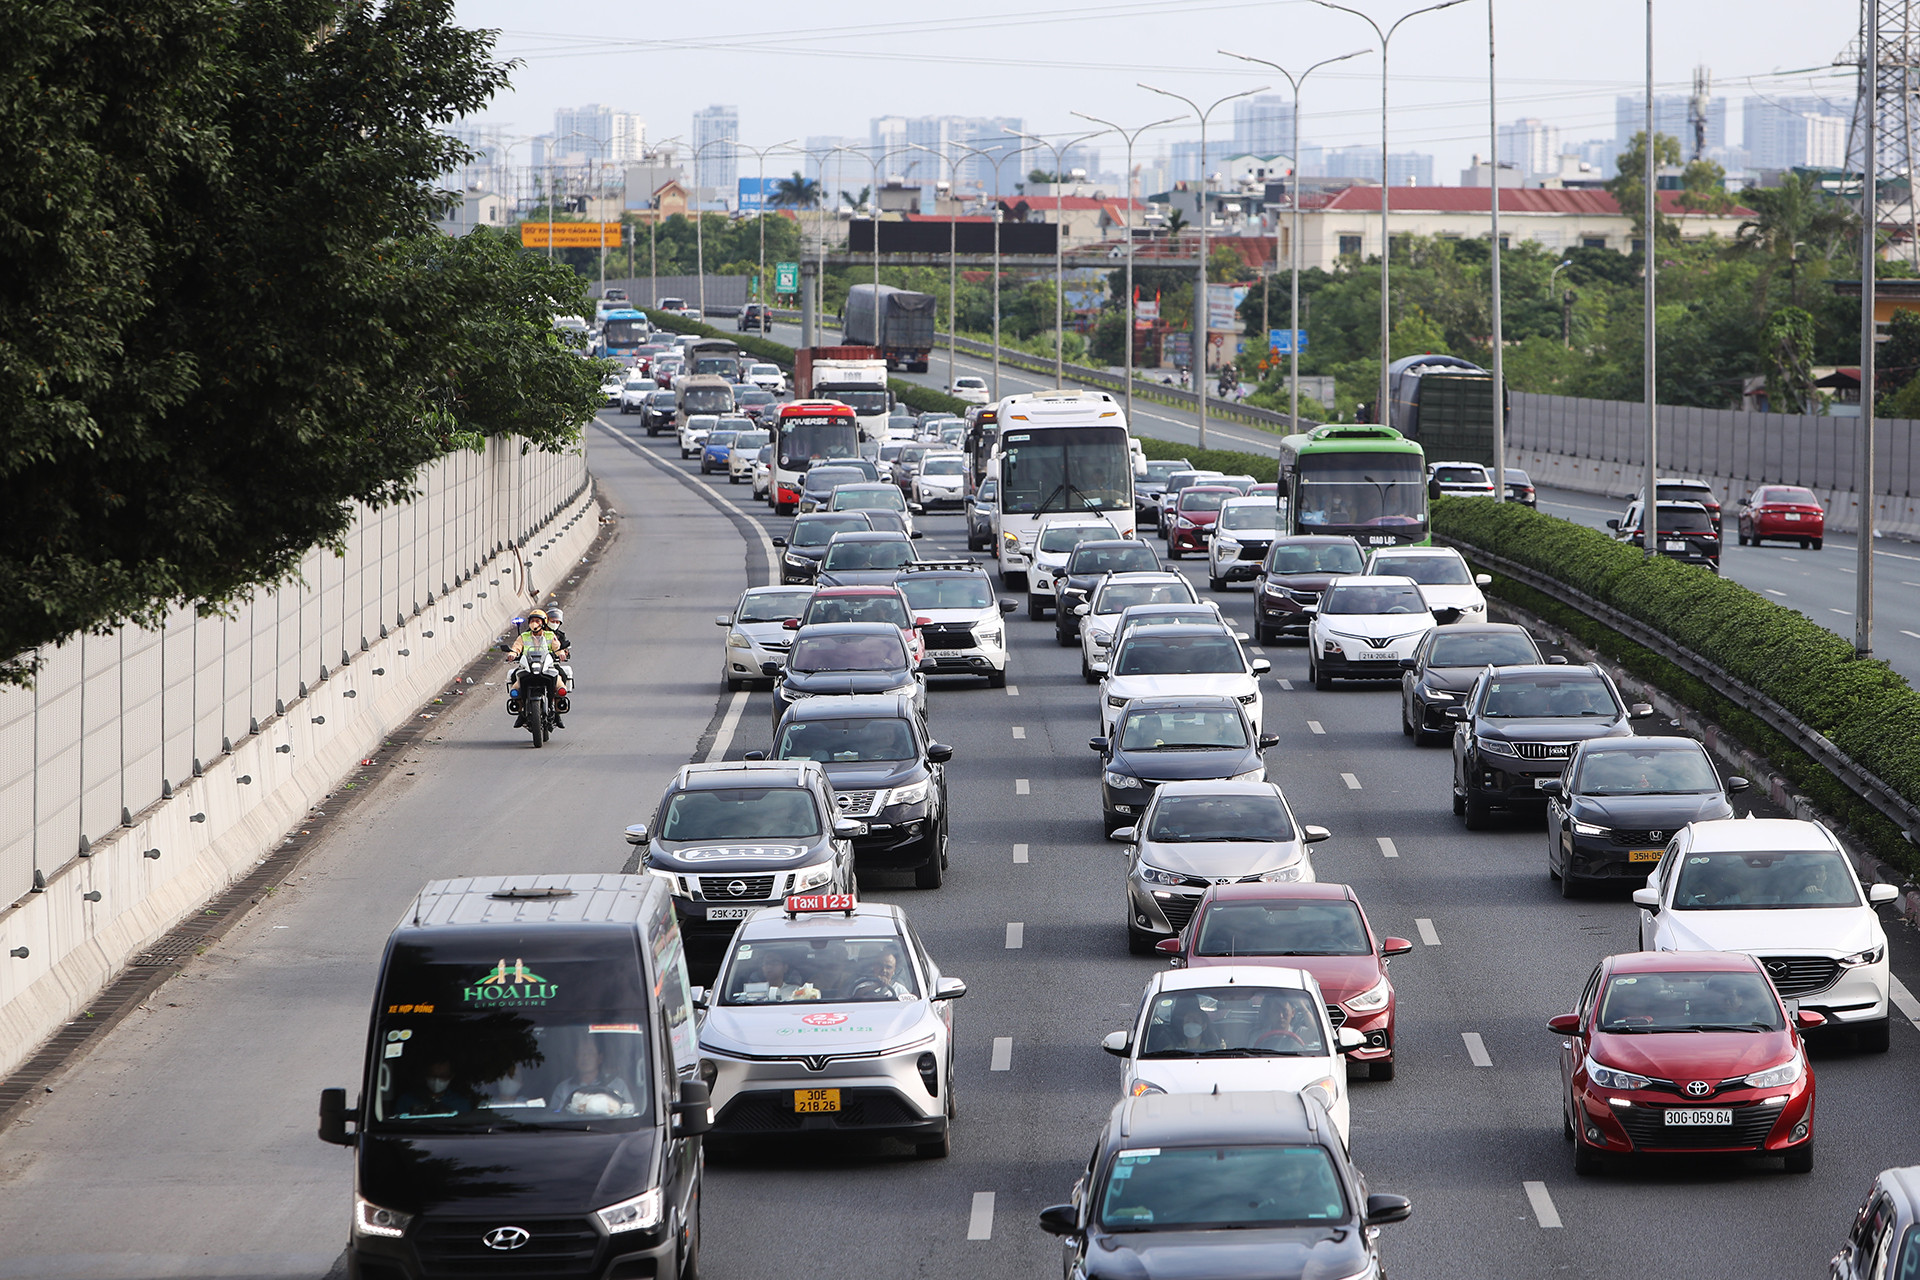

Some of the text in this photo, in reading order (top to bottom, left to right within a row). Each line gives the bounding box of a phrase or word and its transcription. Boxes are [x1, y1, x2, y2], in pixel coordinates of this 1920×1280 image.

[693, 847, 792, 859] ARB
[1633, 851, 1664, 861] 35H-05
[790, 894, 850, 909] Taxi 123
[464, 984, 520, 1001] HOA
[388, 1004, 398, 1014] XE
[474, 1000, 546, 1009] LIMOUSINE
[807, 1090, 828, 1101] 30E
[799, 1101, 836, 1112] 218.26
[1666, 1111, 1731, 1124] 30G-059.64
